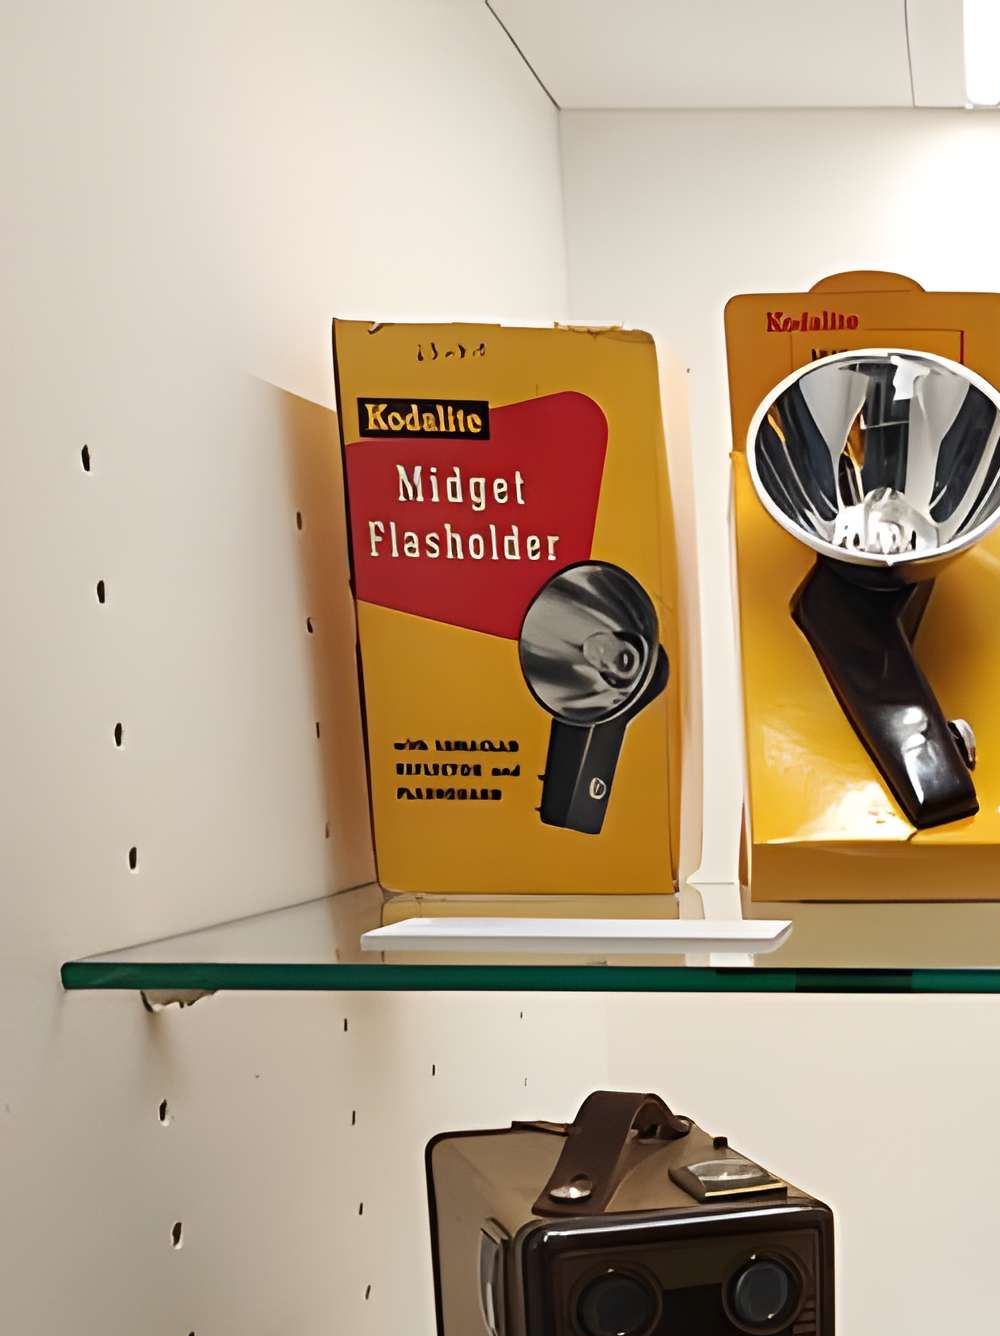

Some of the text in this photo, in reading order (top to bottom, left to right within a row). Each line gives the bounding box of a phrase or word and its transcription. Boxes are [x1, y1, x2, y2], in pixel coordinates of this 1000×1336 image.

[364, 403, 483, 433] Kodalite
[396, 464, 526, 511] Midget
[368, 520, 560, 561] Flasholder
